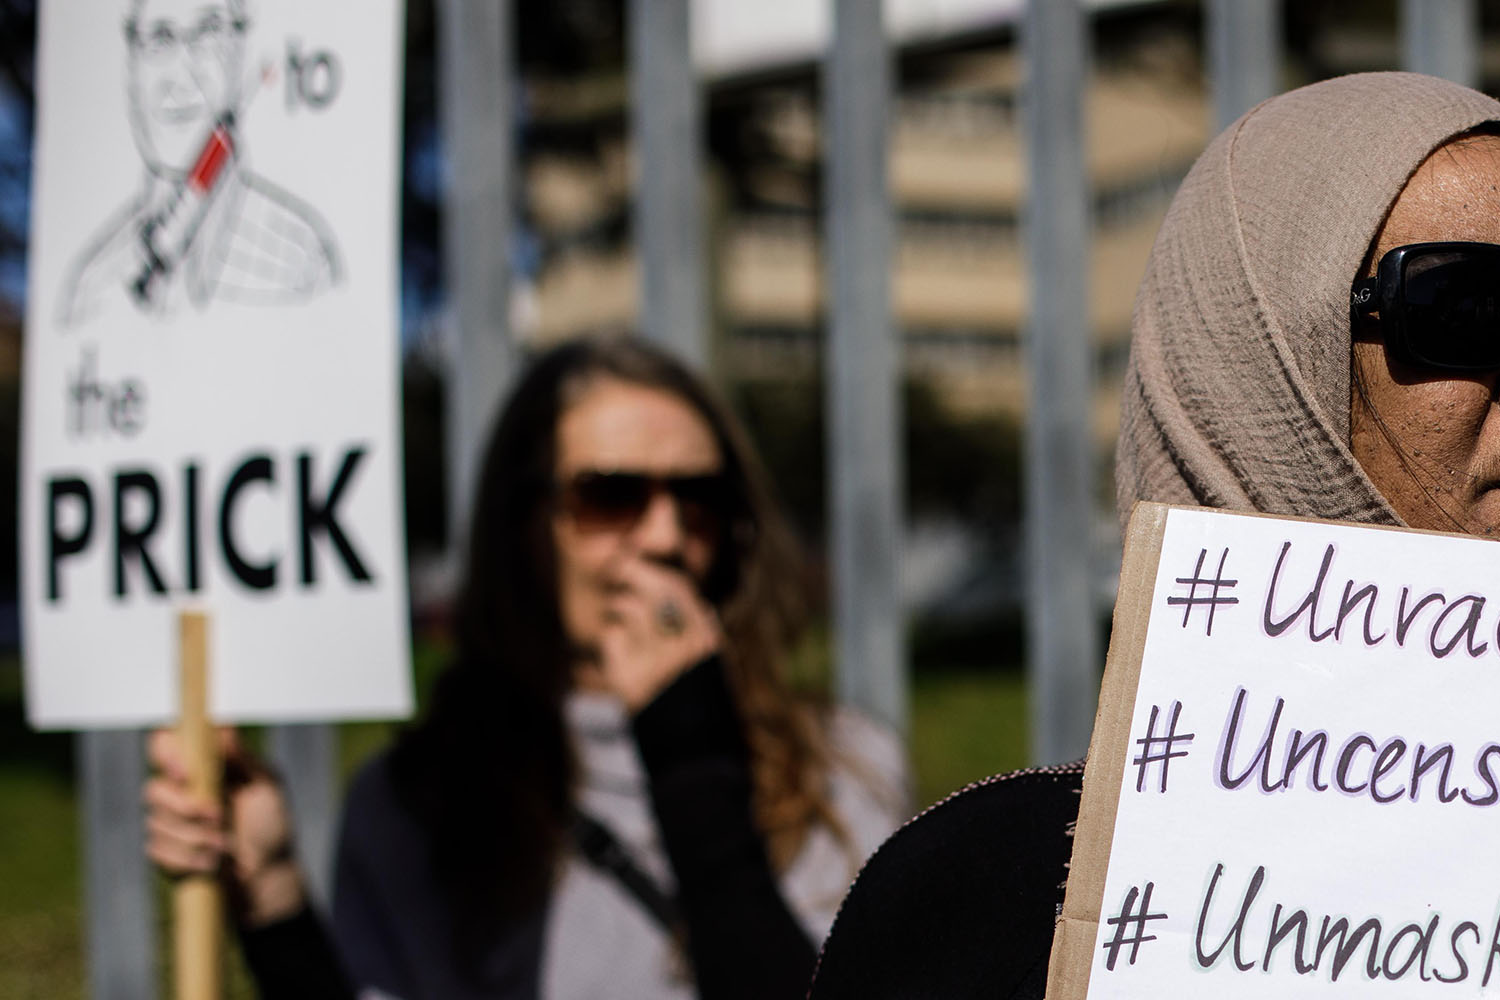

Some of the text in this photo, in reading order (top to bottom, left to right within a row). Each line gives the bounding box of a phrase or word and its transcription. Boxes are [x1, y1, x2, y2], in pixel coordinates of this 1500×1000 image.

[283, 34, 343, 112] to
[65, 346, 145, 436] the
[45, 446, 375, 603] PRICK
